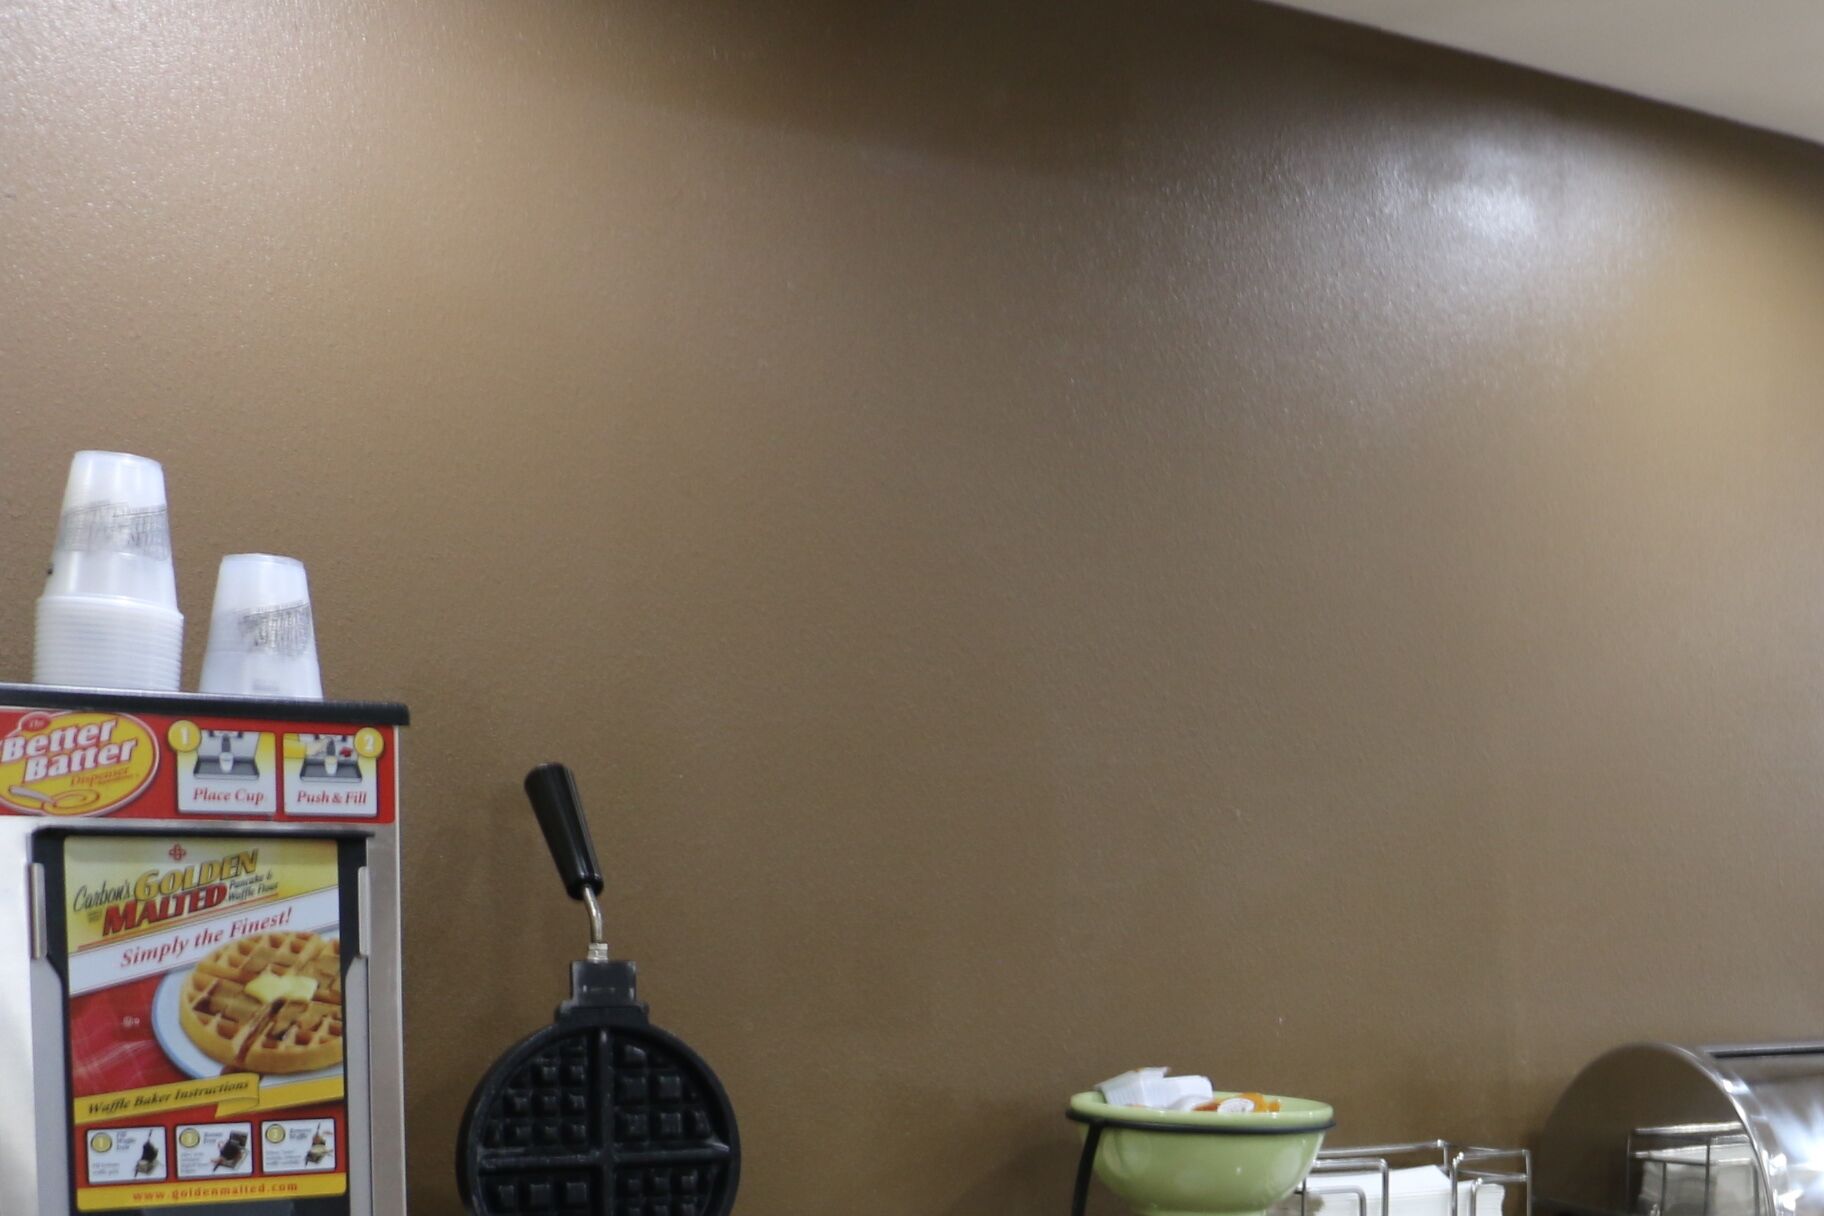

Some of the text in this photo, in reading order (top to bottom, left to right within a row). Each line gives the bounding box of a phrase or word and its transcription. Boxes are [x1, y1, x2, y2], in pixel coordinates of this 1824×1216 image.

[1, 718, 118, 764] Better
[24, 738, 139, 784] Batter
[193, 787, 265, 804] Place Cup
[296, 790, 329, 805] Push
[345, 790, 367, 804] Fill
[134, 848, 259, 900] GOLDEN
[102, 882, 229, 937] MALTED
[119, 906, 294, 969] Simply the Finest!
[88, 1079, 250, 1115] Waffle Baker Instructions
[131, 1181, 300, 1202] www.goldenmalted.com
